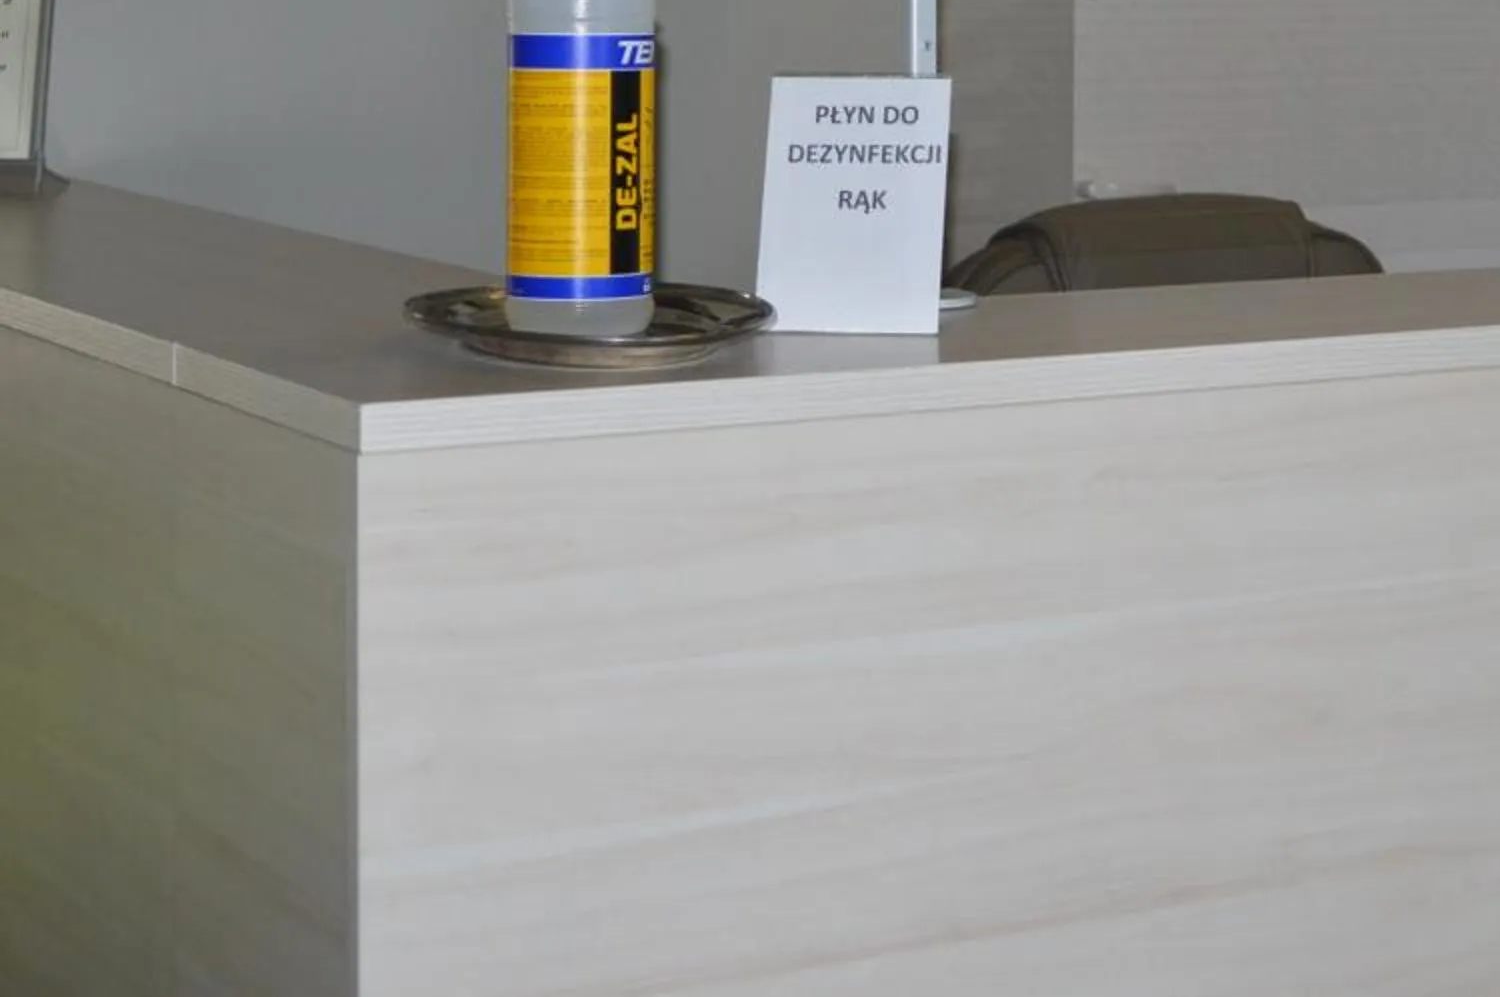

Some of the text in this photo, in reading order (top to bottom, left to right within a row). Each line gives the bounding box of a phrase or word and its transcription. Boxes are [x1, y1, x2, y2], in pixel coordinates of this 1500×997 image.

[618, 40, 655, 65] TE
[814, 105, 920, 125] PŁYN DO
[787, 143, 943, 165] DEZYNFEKCJI
[615, 113, 639, 231] DE-ZAL
[837, 190, 888, 215] RĄK
